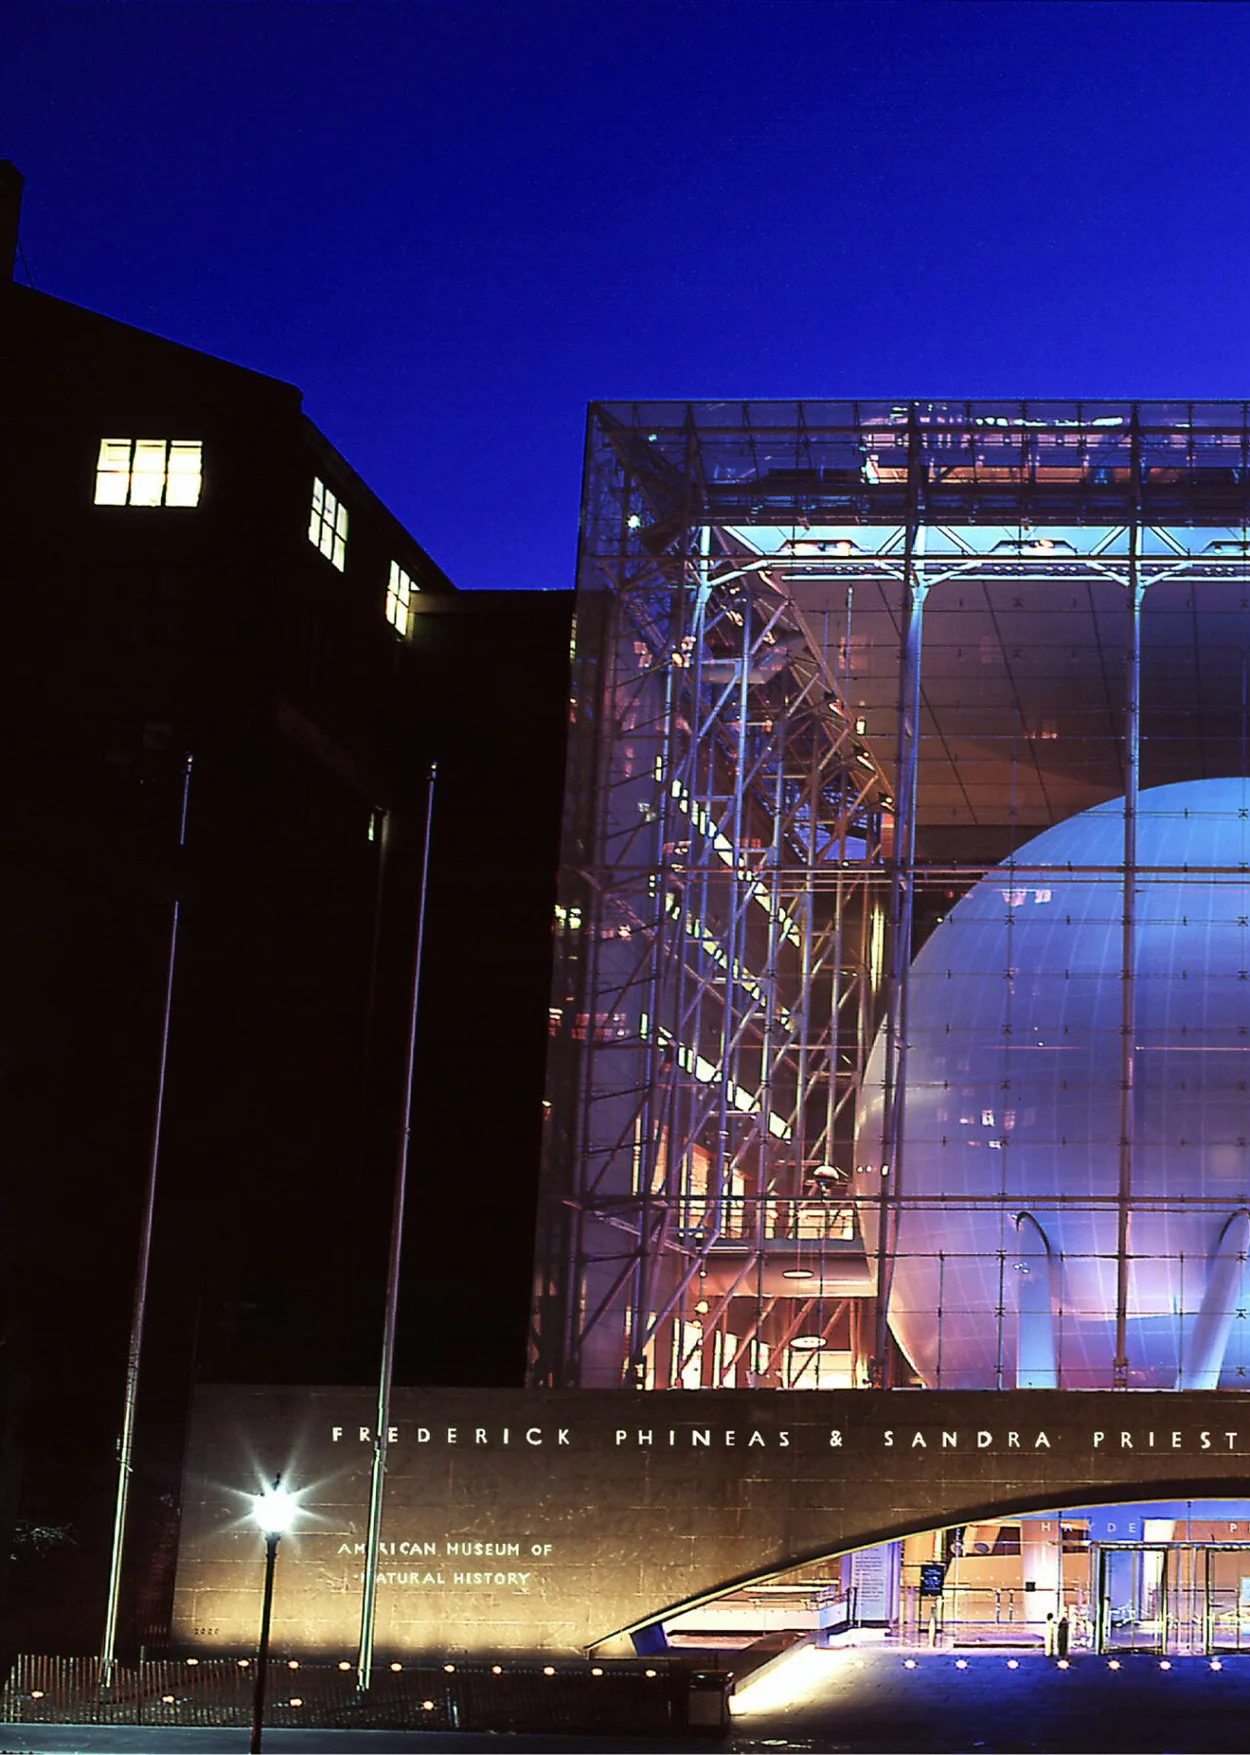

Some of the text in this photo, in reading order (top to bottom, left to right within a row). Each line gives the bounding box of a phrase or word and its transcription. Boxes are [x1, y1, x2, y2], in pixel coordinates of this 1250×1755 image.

[332, 1426, 571, 1446] FREDERICK
[615, 1429, 791, 1447] PHINEAS
[829, 1430, 844, 1447] &
[883, 1430, 1051, 1449] SANDRA
[1093, 1431, 1239, 1450] PRIEST
[337, 1541, 553, 1556] AMRICAN MUSEUM OF
[453, 1571, 531, 1585] HISTORY
